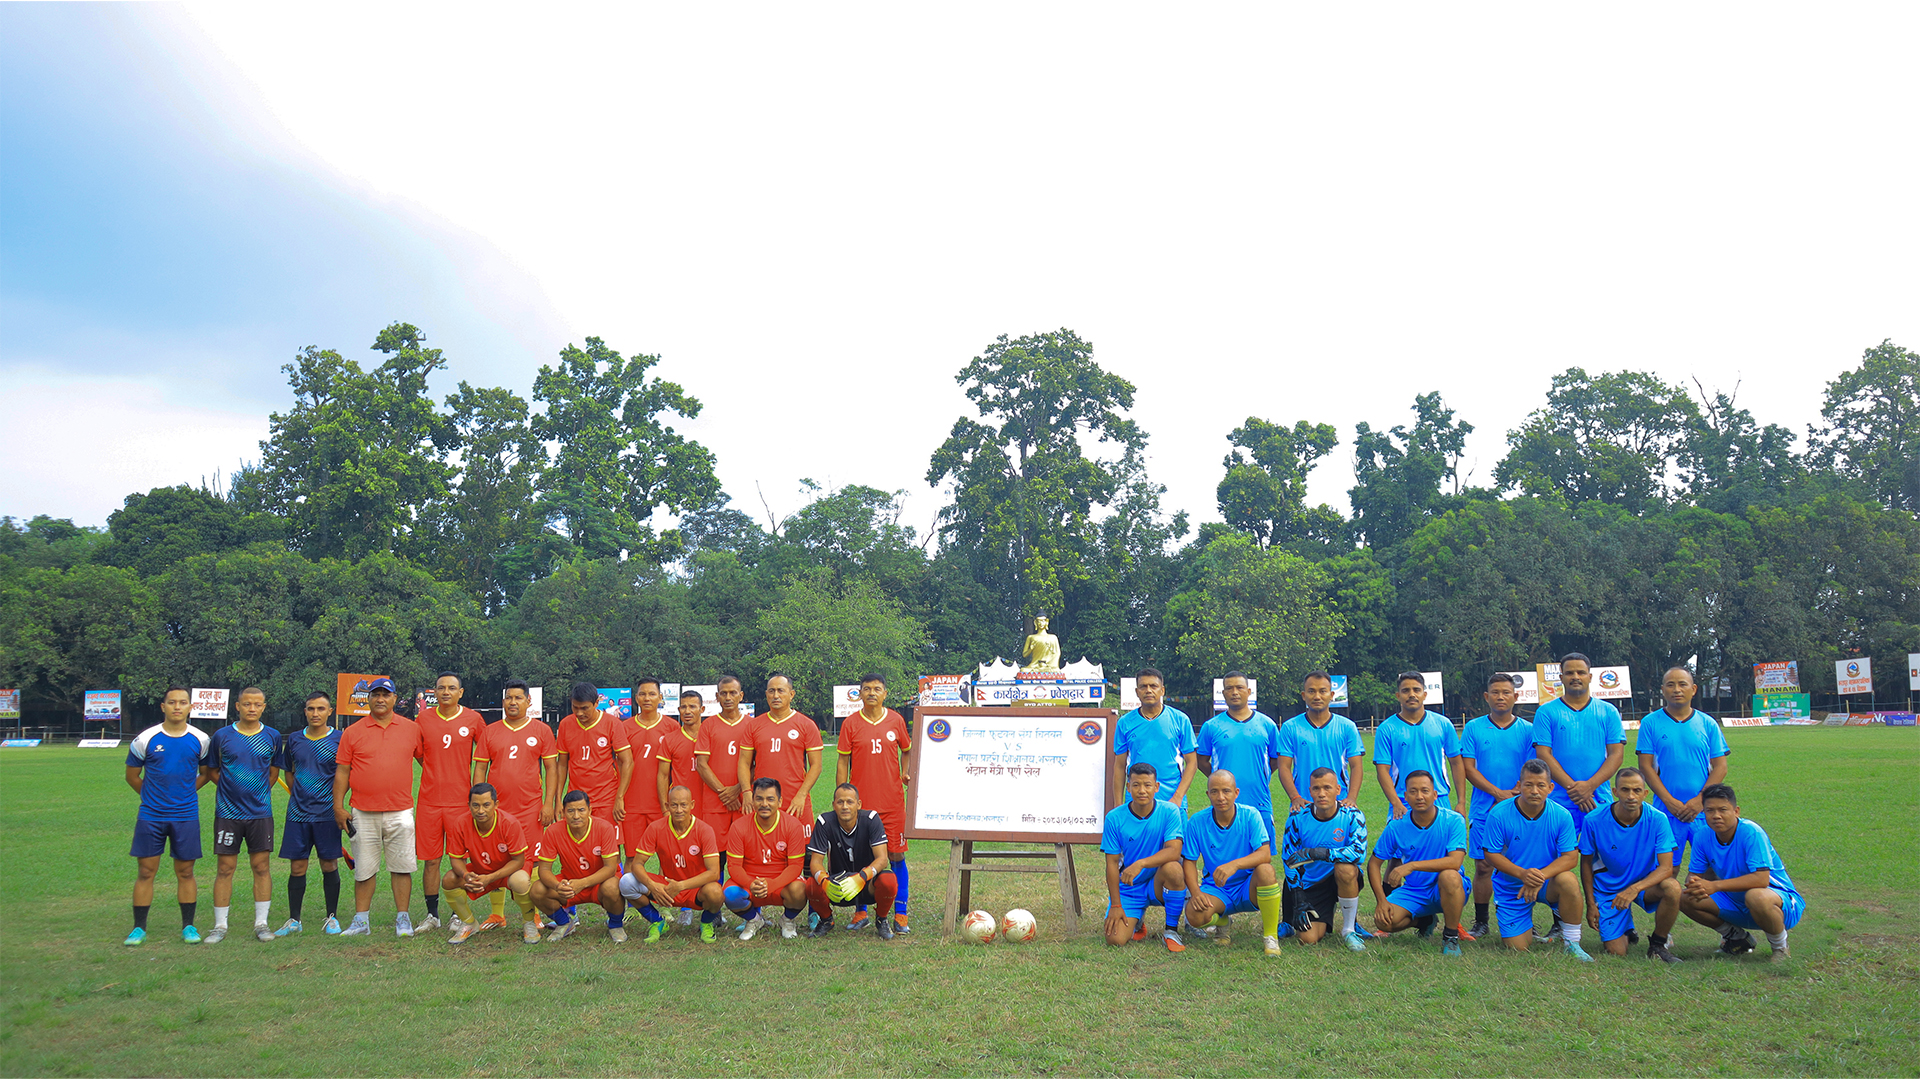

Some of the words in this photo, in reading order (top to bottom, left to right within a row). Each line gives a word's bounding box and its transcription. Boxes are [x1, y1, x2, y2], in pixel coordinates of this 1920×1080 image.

[993, 687, 1029, 700] कार्यक्षेत्र
[1050, 687, 1085, 700] प्रवेशद्वार
[1731, 718, 1764, 726] HANAMI
[442, 734, 452, 749] 9
[728, 740, 737, 755] 6
[770, 737, 781, 753] 10
[871, 738, 882, 754] 15
[509, 745, 518, 759] 2
[581, 745, 591, 761] 17
[643, 744, 652, 759] 7
[957, 750, 979, 762] नेपाल
[691, 757, 698, 771] 1
[1024, 763, 1041, 778] खेल
[1085, 815, 1098, 827] गते
[217, 830, 235, 846] 15
[534, 842, 542, 856] 2
[847, 847, 854, 862] 1
[481, 851, 491, 865] 3
[579, 856, 590, 870] 5
[675, 854, 687, 868] 30
[762, 849, 771, 864] 14
